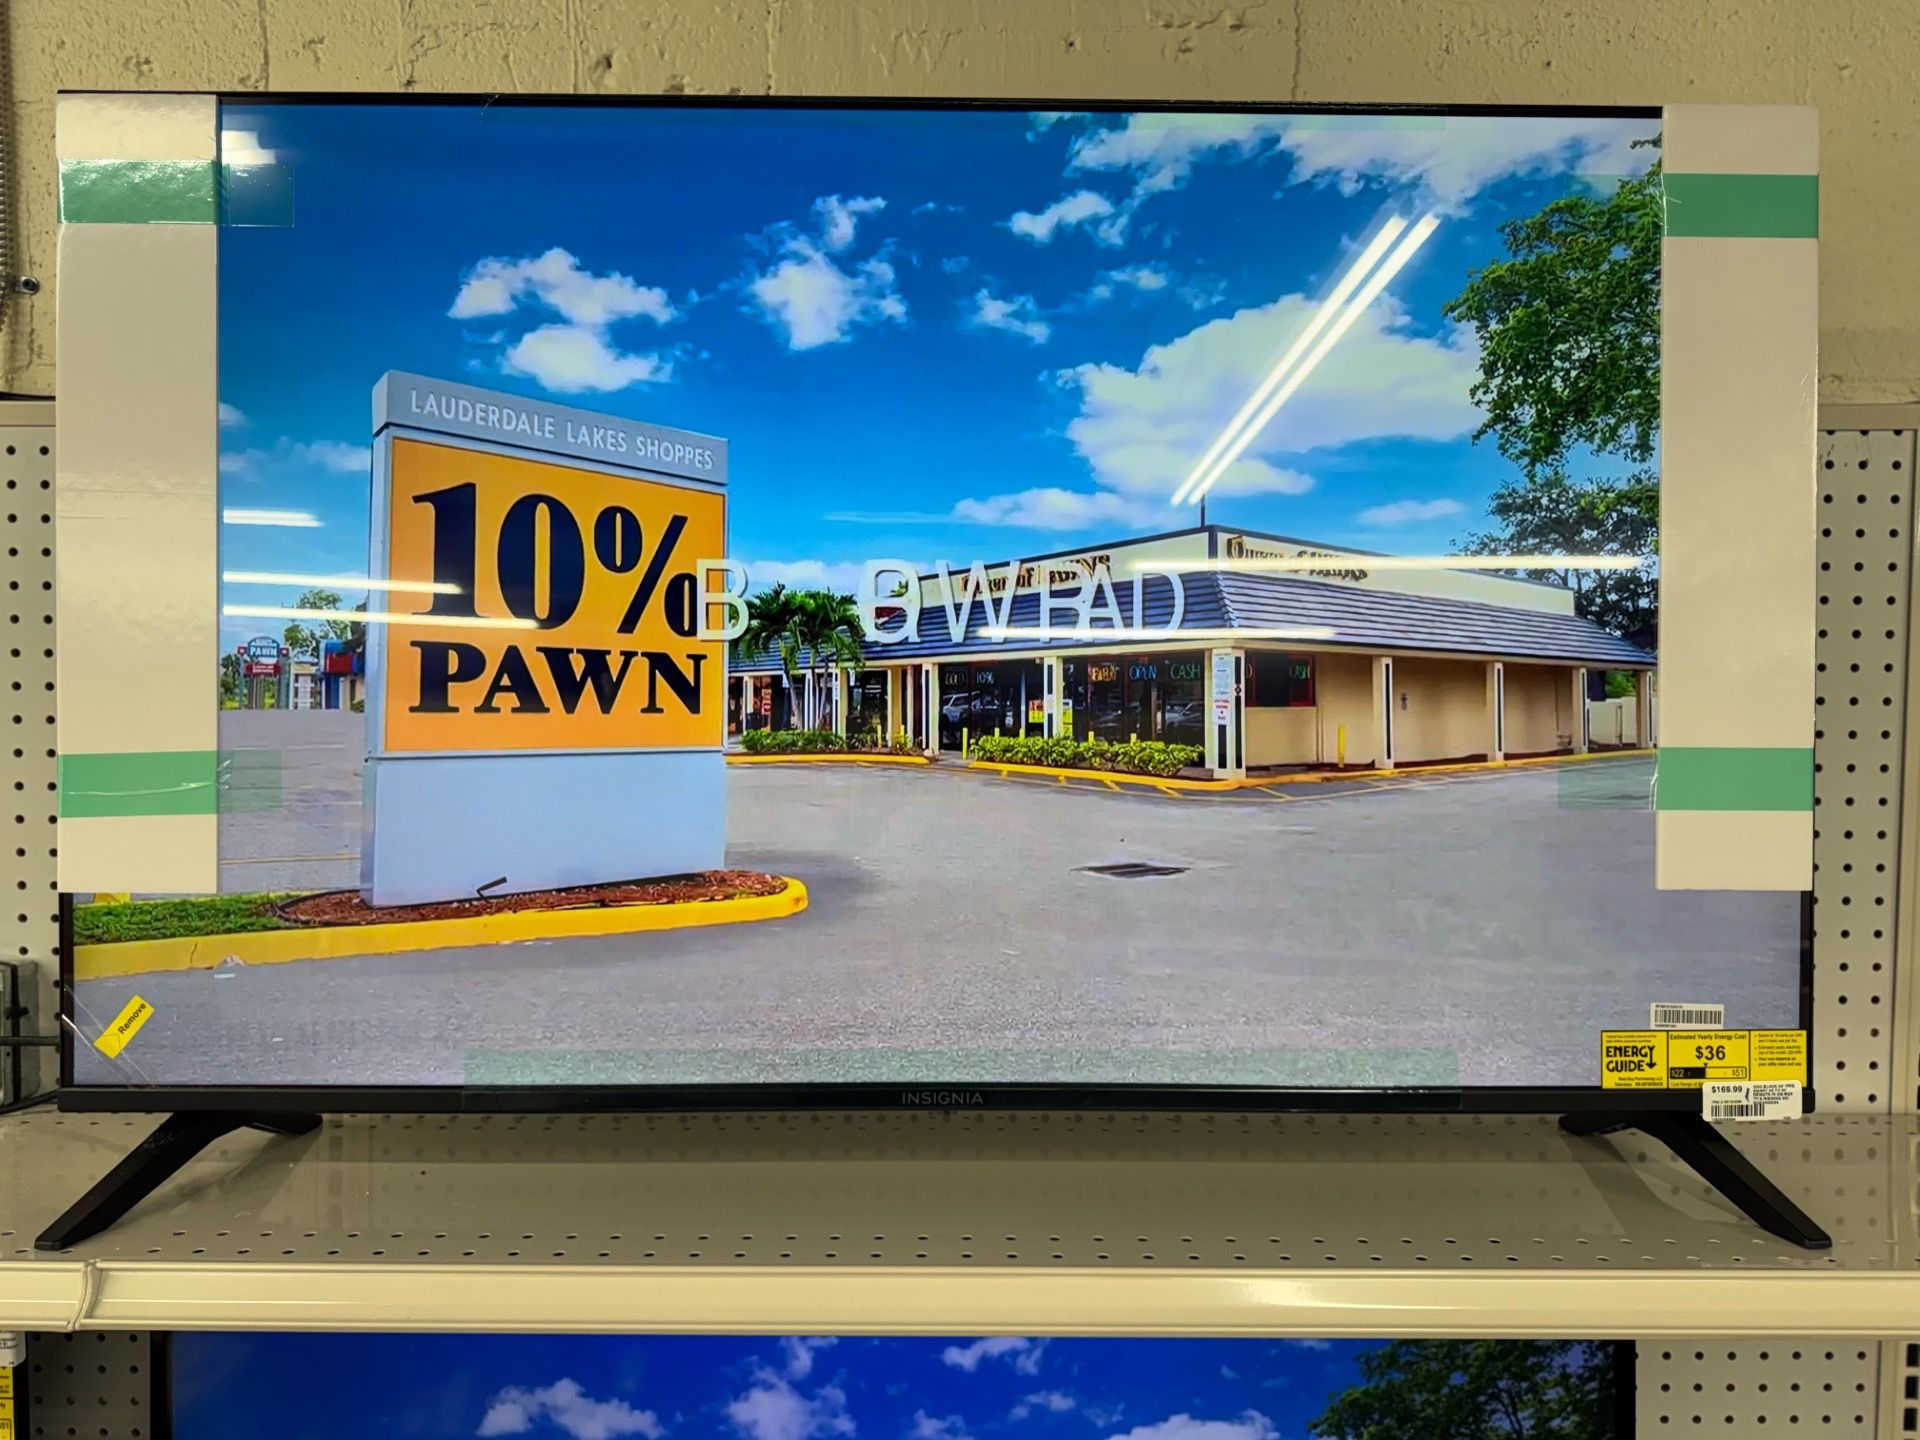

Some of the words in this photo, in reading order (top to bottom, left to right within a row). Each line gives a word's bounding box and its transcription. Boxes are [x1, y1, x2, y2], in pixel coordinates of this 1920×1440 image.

[410, 389, 556, 440] LAUDERDALE
[565, 421, 628, 453] LAKES
[635, 434, 714, 471] SHOPPES
[411, 482, 699, 639] 10%
[408, 639, 709, 716] PAWN
[1170, 663, 1201, 680] CASH
[117, 1002, 147, 1035] Remove
[1697, 1033, 1713, 1041] Yearly
[1714, 1033, 1733, 1041] Energy
[1605, 1045, 1656, 1058] ENERGY
[1695, 1045, 1726, 1061] $36
[1605, 1060, 1646, 1073] GUIDE
[1731, 1068, 1744, 1077] $51
[1711, 1085, 1743, 1094] $169.99
[901, 1091, 985, 1105] INSIGNIA
